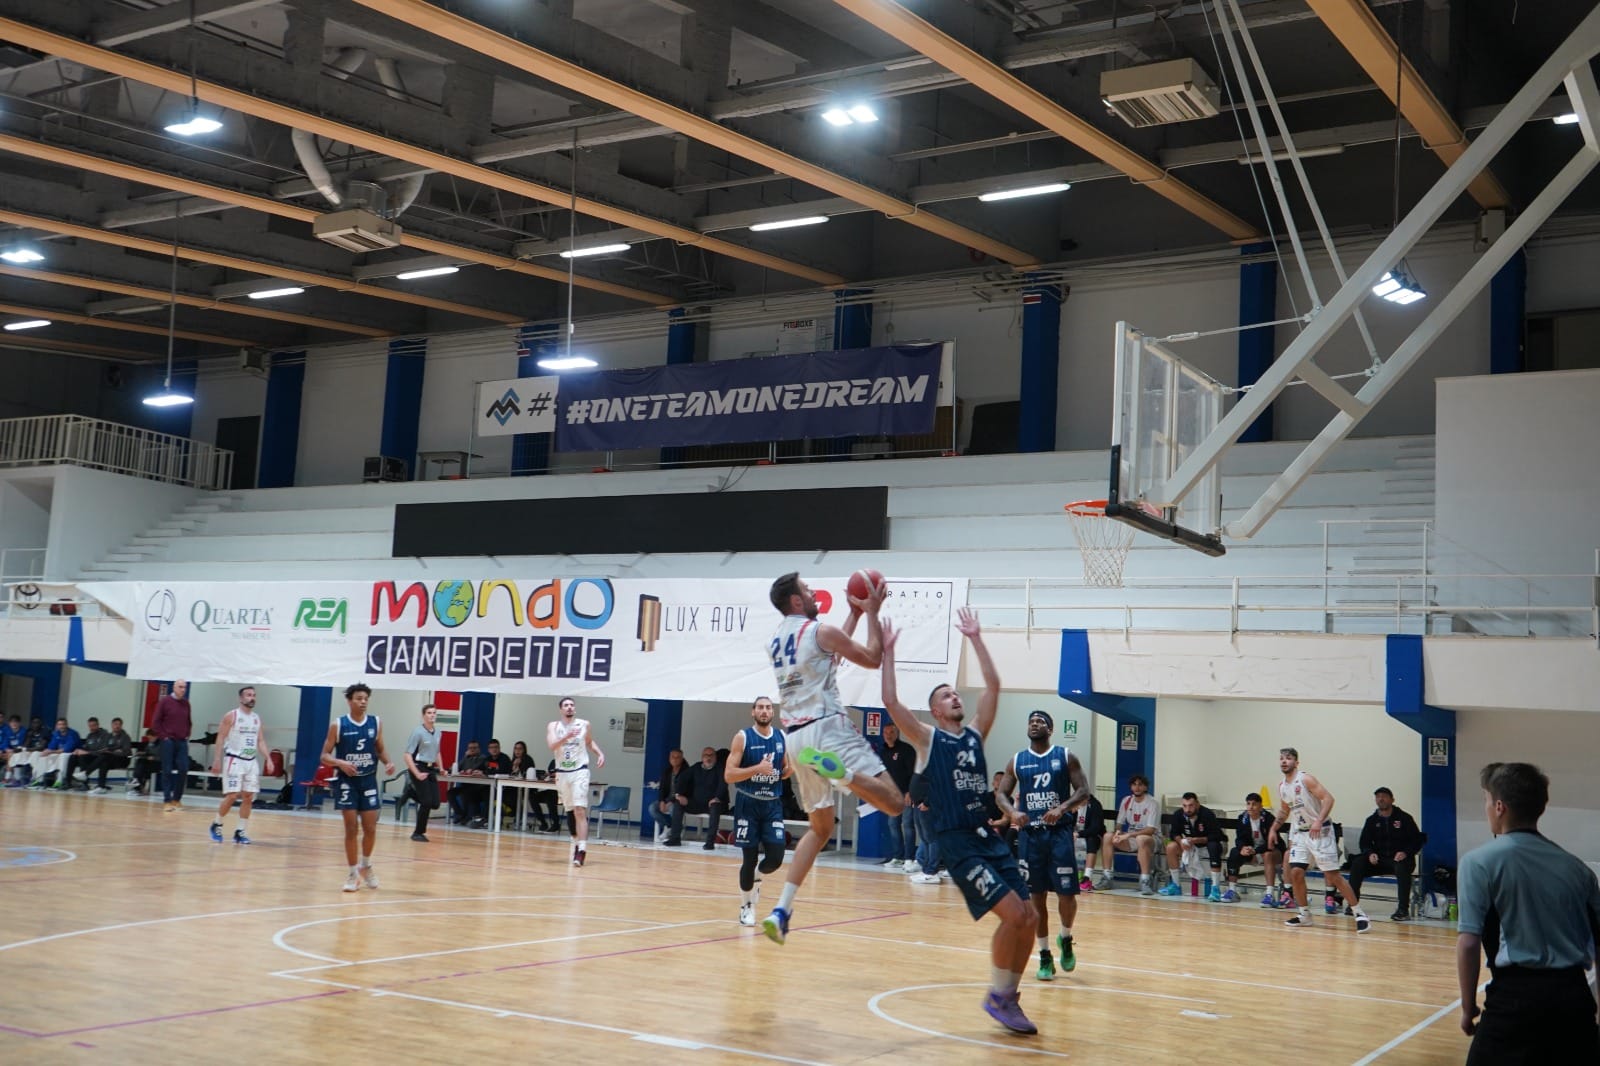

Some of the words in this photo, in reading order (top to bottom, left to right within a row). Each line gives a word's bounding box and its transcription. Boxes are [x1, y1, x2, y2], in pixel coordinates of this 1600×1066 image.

[294, 598, 348, 634] REA
[664, 605, 699, 632] LUX
[367, 637, 611, 678] CAMERETTE
[770, 633, 797, 668] 24
[356, 739, 367, 750] 5
[1033, 771, 1052, 789] 79
[340, 790, 350, 802] 5
